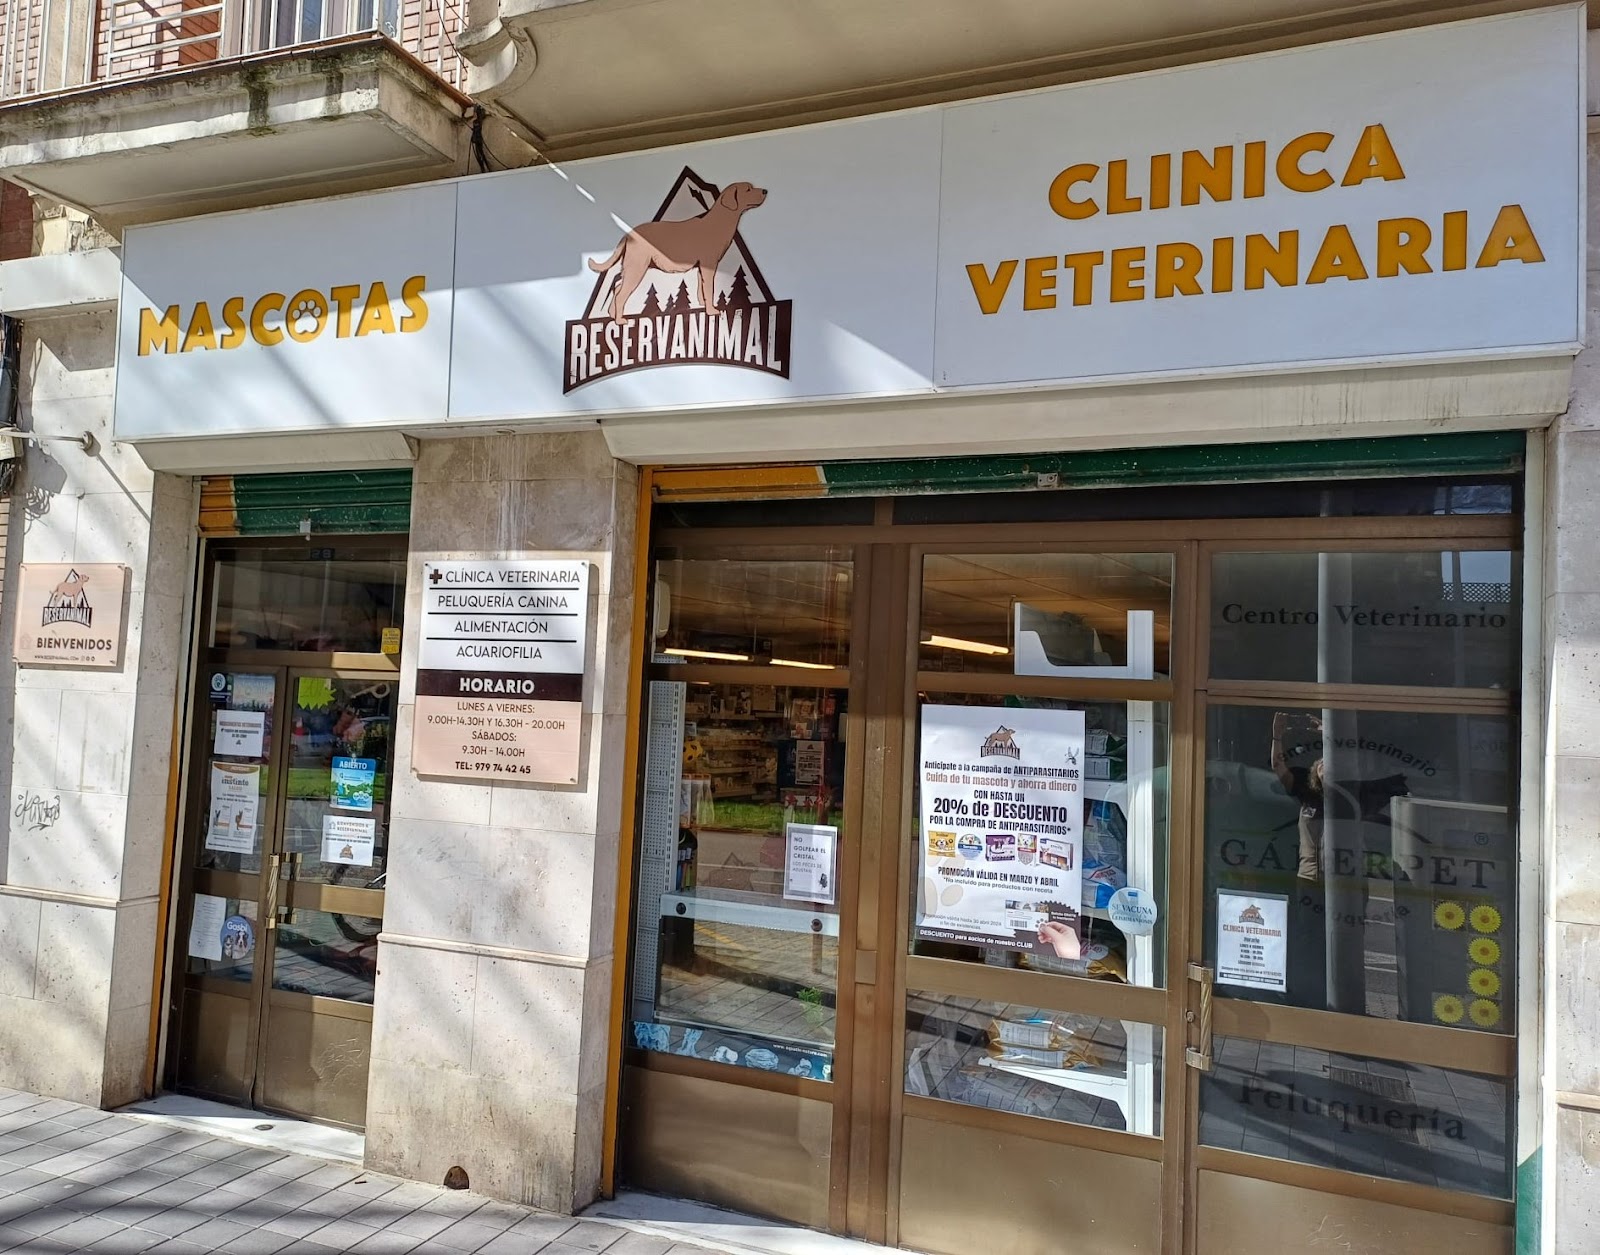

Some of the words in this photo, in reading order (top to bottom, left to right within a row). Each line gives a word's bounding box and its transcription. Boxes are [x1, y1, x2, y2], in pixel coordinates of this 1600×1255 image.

[1048, 122, 1406, 221] CLINICA
[965, 204, 1546, 315] VETERINARIA
[138, 276, 429, 357] MASCOTAS
[569, 305, 782, 386] RESERVANIMAL
[446, 568, 494, 583] CLÍNICA
[498, 570, 580, 583] VETERINARIA
[438, 593, 514, 608] PELUQUERÍA
[518, 596, 568, 608] CANINA
[1222, 603, 1319, 625] Centro
[1333, 603, 1507, 629] Veterinario
[454, 618, 548, 634] ALIMENTACIÓN
[37, 637, 112, 651] BIENVENIDOS
[456, 645, 542, 659] ACUARIOFILIA
[459, 677, 535, 694] HORARIO
[457, 701, 485, 712] LUNES
[487, 703, 494, 712] A
[496, 703, 535, 714] VIERNES:
[486, 717, 492, 727] Y
[495, 718, 523, 728] 16.30H
[532, 720, 566, 731] 20.00H
[472, 729, 517, 742] SÁBADOS:
[462, 745, 487, 756] 9.30H
[495, 747, 525, 758] 14.00H
[1334, 736, 1436, 778] veterinario
[339, 760, 368, 770] ABIERTO
[455, 761, 473, 771] TEL:
[474, 762, 491, 772] 979
[493, 764, 502, 772] 74
[505, 764, 517, 773] 42
[519, 765, 531, 774] 45
[1003, 766, 1012, 775] de
[1014, 766, 1079, 779] ANTIPARASITARIOS
[926, 772, 948, 783] Cuida
[950, 774, 960, 784] de
[962, 774, 970, 785] tu
[972, 776, 1008, 787] mascota
[1011, 780, 1016, 789] y
[1018, 779, 1046, 790] ahorra
[1049, 780, 1077, 792] dinero
[974, 789, 988, 800] CON
[990, 790, 1012, 801] HASTA
[934, 797, 969, 815] 20%
[972, 800, 989, 817] de
[994, 802, 1067, 823] DESCUENTO
[930, 815, 943, 825] POR
[945, 816, 953, 826] LA
[956, 817, 986, 828] COMPRA
[988, 820, 997, 830] DE
[794, 845, 819, 853] GOLPEAR
[1220, 837, 1496, 889] GÁERPET
[1000, 872, 1008, 881] EN
[1010, 874, 1033, 884] MARZO
[1034, 876, 1039, 885] Y
[1040, 877, 1059, 887] ABRIL
[1122, 904, 1152, 915] VACUNA
[227, 921, 248, 932] Gosbi
[920, 929, 954, 939] DESCUENTO
[1016, 941, 1033, 949] CLUB
[1240, 1077, 1467, 1140] Peluquería
